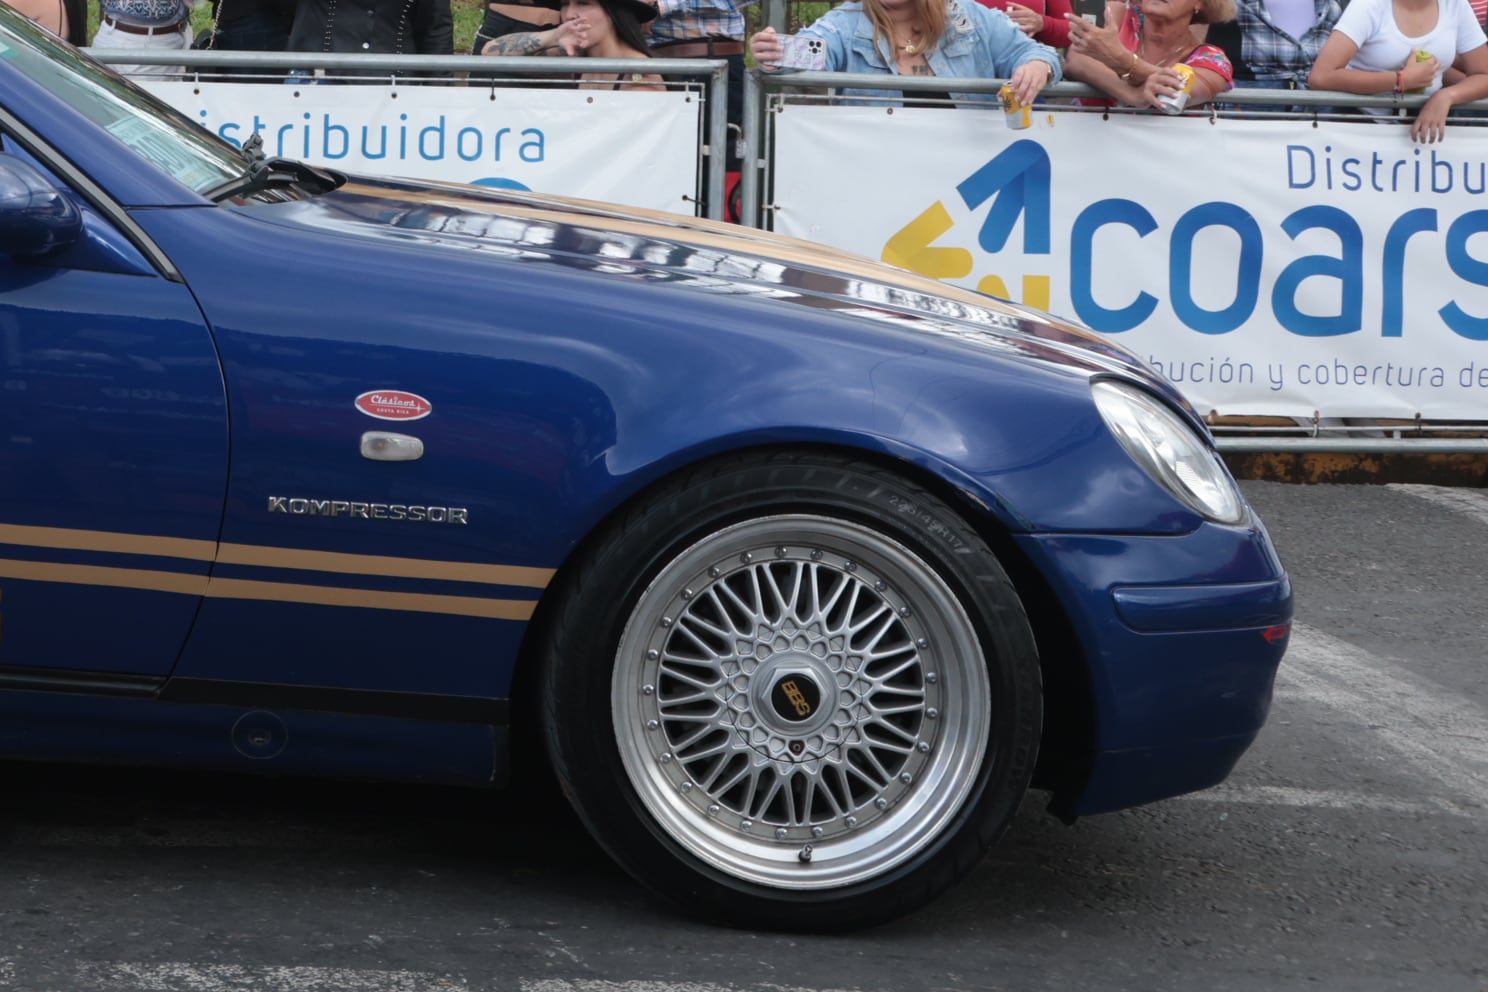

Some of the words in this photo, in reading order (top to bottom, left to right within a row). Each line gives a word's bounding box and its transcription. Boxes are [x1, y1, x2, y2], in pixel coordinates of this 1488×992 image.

[199, 110, 546, 163] stribuidora
[1287, 145, 1486, 194] Distribu
[1268, 363, 1284, 391] y
[1297, 358, 1445, 387] cobertura
[268, 496, 469, 524] KOMPRESSOR
[781, 680, 811, 717] BBS
